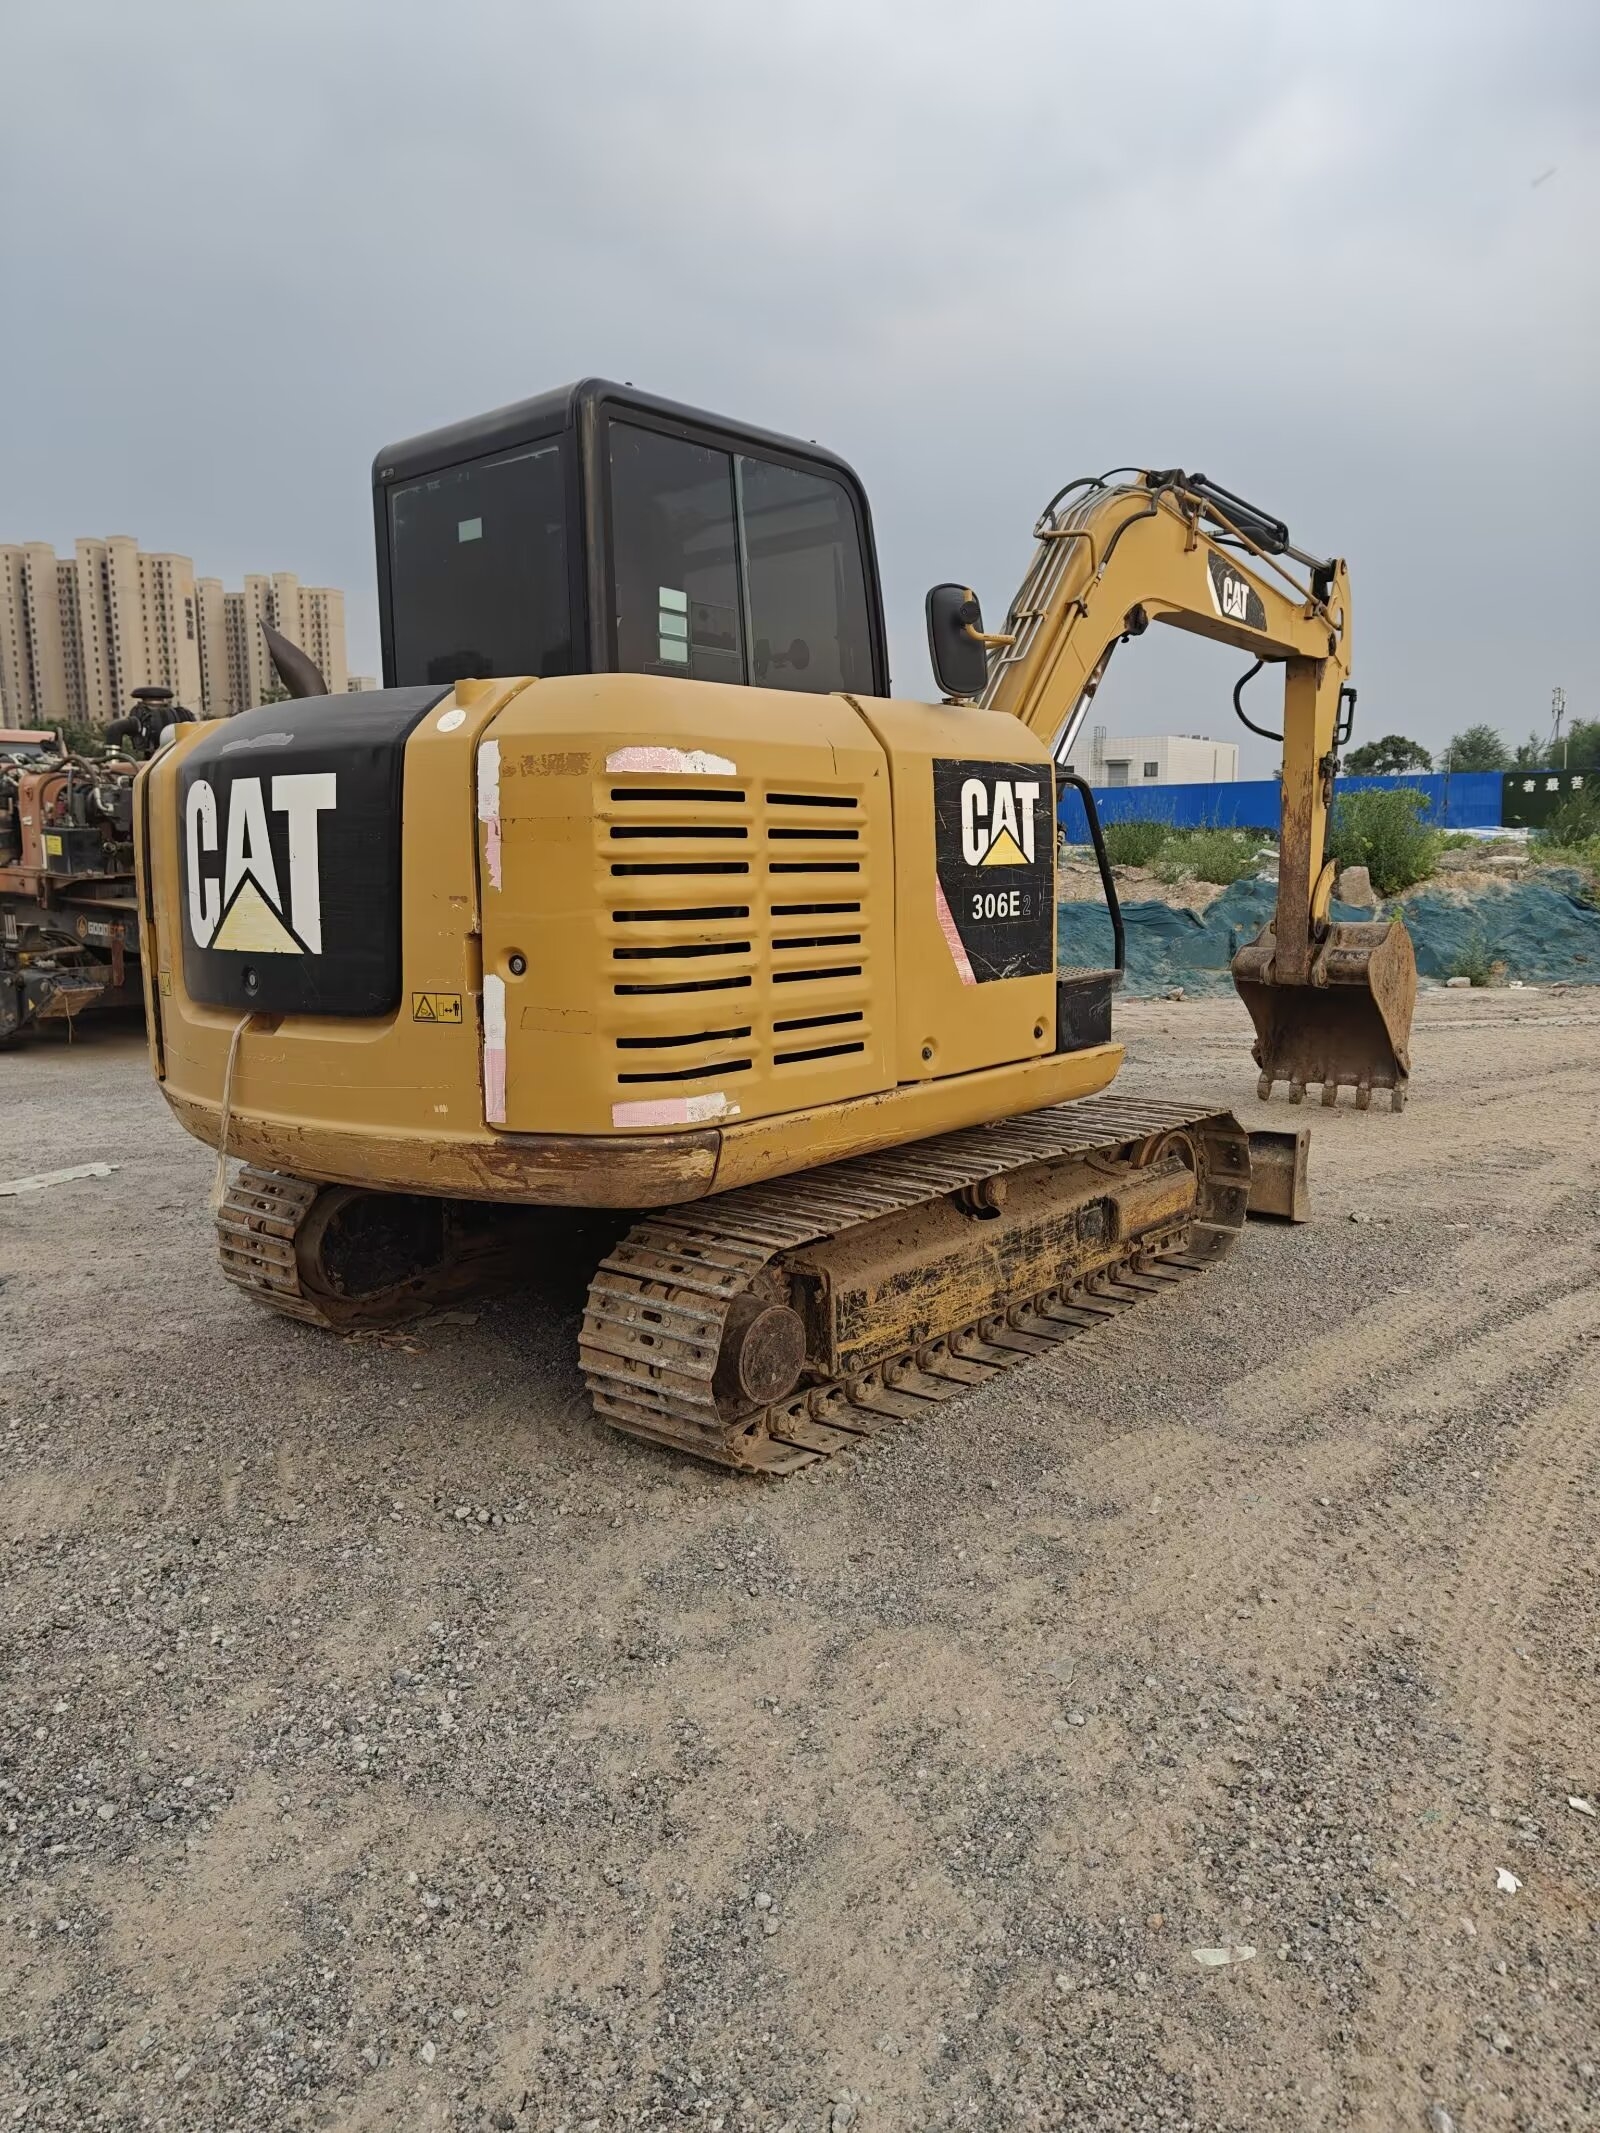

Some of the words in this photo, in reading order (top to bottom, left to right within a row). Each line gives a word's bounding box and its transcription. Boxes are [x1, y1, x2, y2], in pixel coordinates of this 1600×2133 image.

[1223, 577, 1249, 621] CAT
[186, 772, 337, 955] CAT
[961, 778, 1040, 867] CAT
